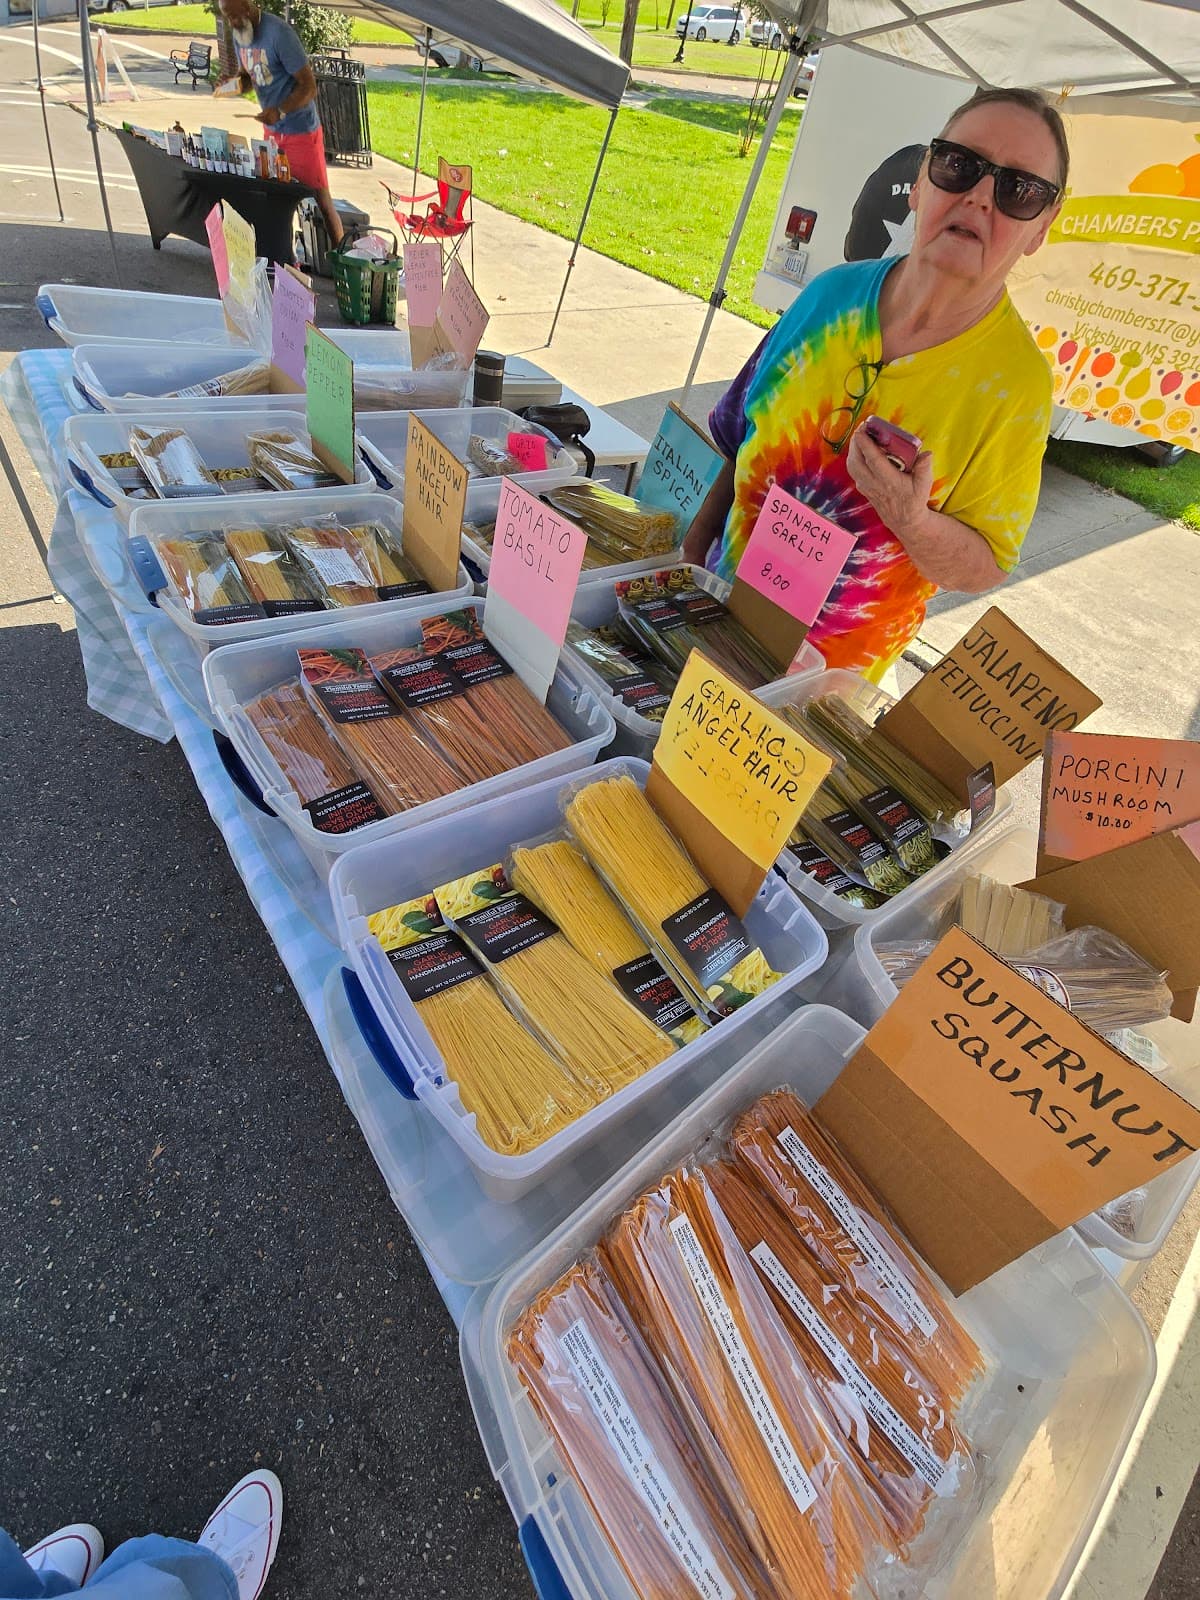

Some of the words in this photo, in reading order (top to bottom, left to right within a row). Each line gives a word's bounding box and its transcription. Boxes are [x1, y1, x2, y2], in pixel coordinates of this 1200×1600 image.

[1062, 214, 1182, 239] CHAMBERS
[1182, 221, 1200, 243] P
[1046, 289, 1200, 348] christychambers17@y
[312, 338, 342, 377] LEMON
[1141, 341, 1168, 361] MS
[308, 362, 344, 405] PEPPER
[412, 426, 462, 492] RAINBOW
[654, 434, 702, 496] ITALIAN
[416, 459, 448, 507] ANGEL
[653, 460, 692, 512] SPICE
[419, 484, 442, 524] HAIR
[503, 486, 570, 554] TOMATO
[770, 500, 832, 544] SPINACH
[504, 523, 554, 582] BASIL
[772, 522, 824, 562] GARLIC
[760, 562, 790, 590] 8.00
[963, 626, 1078, 731] JALAPENO
[700, 679, 786, 757] GARLIC
[931, 656, 1042, 761] FETTUCCINI
[680, 694, 738, 756] ANGEL
[743, 750, 798, 802] HAIR
[1060, 754, 1184, 788] PORCINI
[315, 805, 336, 817] PASTA
[326, 798, 367, 819] LINGUINI
[335, 790, 371, 808] HANDMADE
[344, 800, 377, 818] OMATO
[1053, 787, 1172, 814] MUSHROOM
[329, 808, 377, 833] SUNDRIED
[467, 908, 497, 924] Plentiful
[482, 922, 512, 939] ANGEL
[511, 912, 534, 926] HAIR
[485, 925, 521, 944] HANDMADE
[519, 917, 539, 929] PASTA
[487, 912, 519, 930] GARLIC
[696, 910, 727, 933] HANDMADE
[704, 917, 730, 938] ANGEL
[681, 929, 700, 944] PASTA
[686, 933, 708, 951] HAIR
[699, 929, 729, 953] GARLIC
[720, 940, 746, 961] Plentiful
[392, 943, 426, 960] Plentiful
[405, 958, 439, 975] ANGEL
[439, 949, 463, 962] HAIR
[412, 948, 448, 966] GARLIC
[408, 962, 447, 981] HANDMADE
[446, 955, 467, 966] PASTA
[638, 986, 657, 1002] HAIR
[936, 956, 1199, 1162] BUTTERNUT
[931, 1012, 1112, 1168] SQUASH
[573, 1325, 592, 1355] BUTTERNUT
[591, 1356, 605, 1378] SQUASH
[561, 1336, 579, 1364] CHAMBERS
[577, 1365, 591, 1384] PASTA
[609, 1425, 633, 1463] WASHINGTON
[642, 1462, 667, 1501] dehydrated
[665, 1501, 688, 1538] butternut
